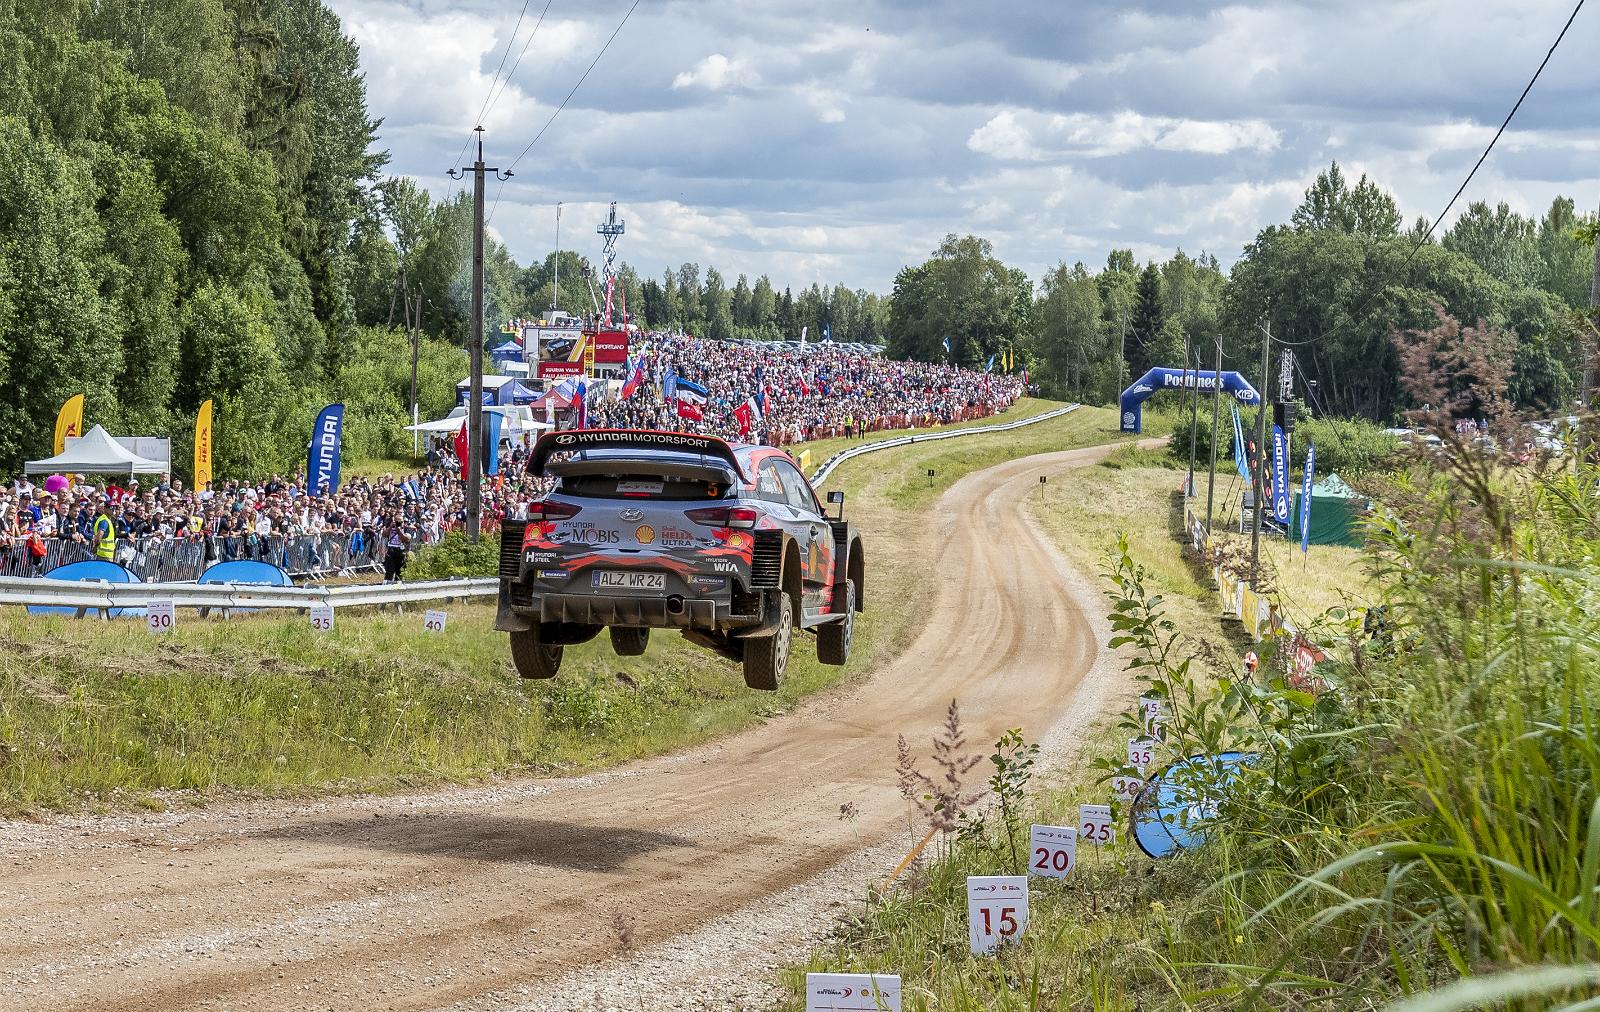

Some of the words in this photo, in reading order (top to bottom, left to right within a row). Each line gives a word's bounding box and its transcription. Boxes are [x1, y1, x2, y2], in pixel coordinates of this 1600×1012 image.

[578, 433, 632, 443] HYUNDAI
[633, 433, 710, 448] MOTORSPORT
[563, 521, 595, 529] HYUNDAI
[571, 528, 620, 544] MOBIS
[661, 530, 695, 540] HELIX
[601, 573, 625, 586] ALZ
[629, 574, 644, 587] WR
[646, 575, 662, 587] 24
[151, 614, 170, 628] 30
[313, 618, 330, 630] 35
[426, 620, 443, 633] 40
[1131, 751, 1150, 763] 35
[1083, 822, 1110, 841] 25
[1034, 847, 1069, 872] 20
[980, 907, 1018, 936] 15
